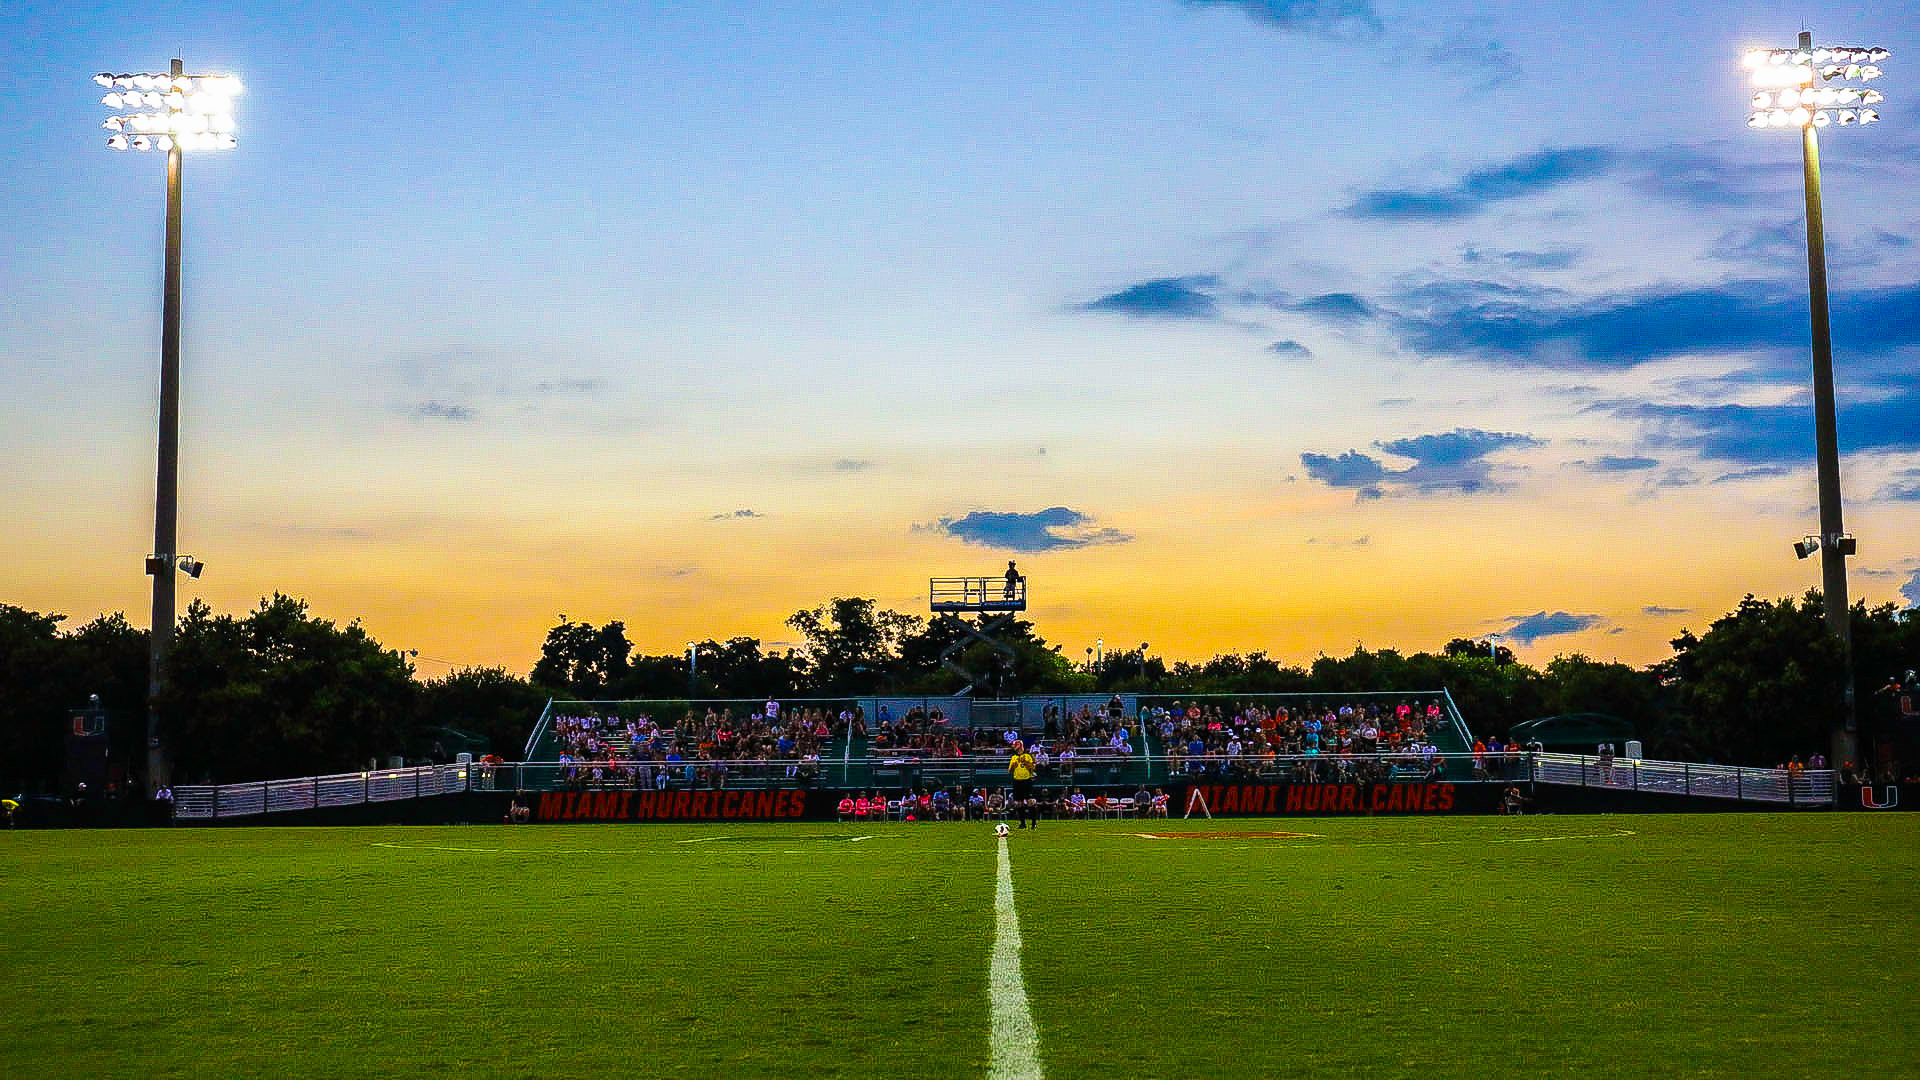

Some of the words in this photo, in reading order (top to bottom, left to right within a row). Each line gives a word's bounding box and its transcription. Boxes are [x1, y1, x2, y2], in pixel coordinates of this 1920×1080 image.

[538, 791, 632, 819] MIAMI
[638, 790, 806, 817] HURRICANES
[1861, 786, 1898, 808] U
